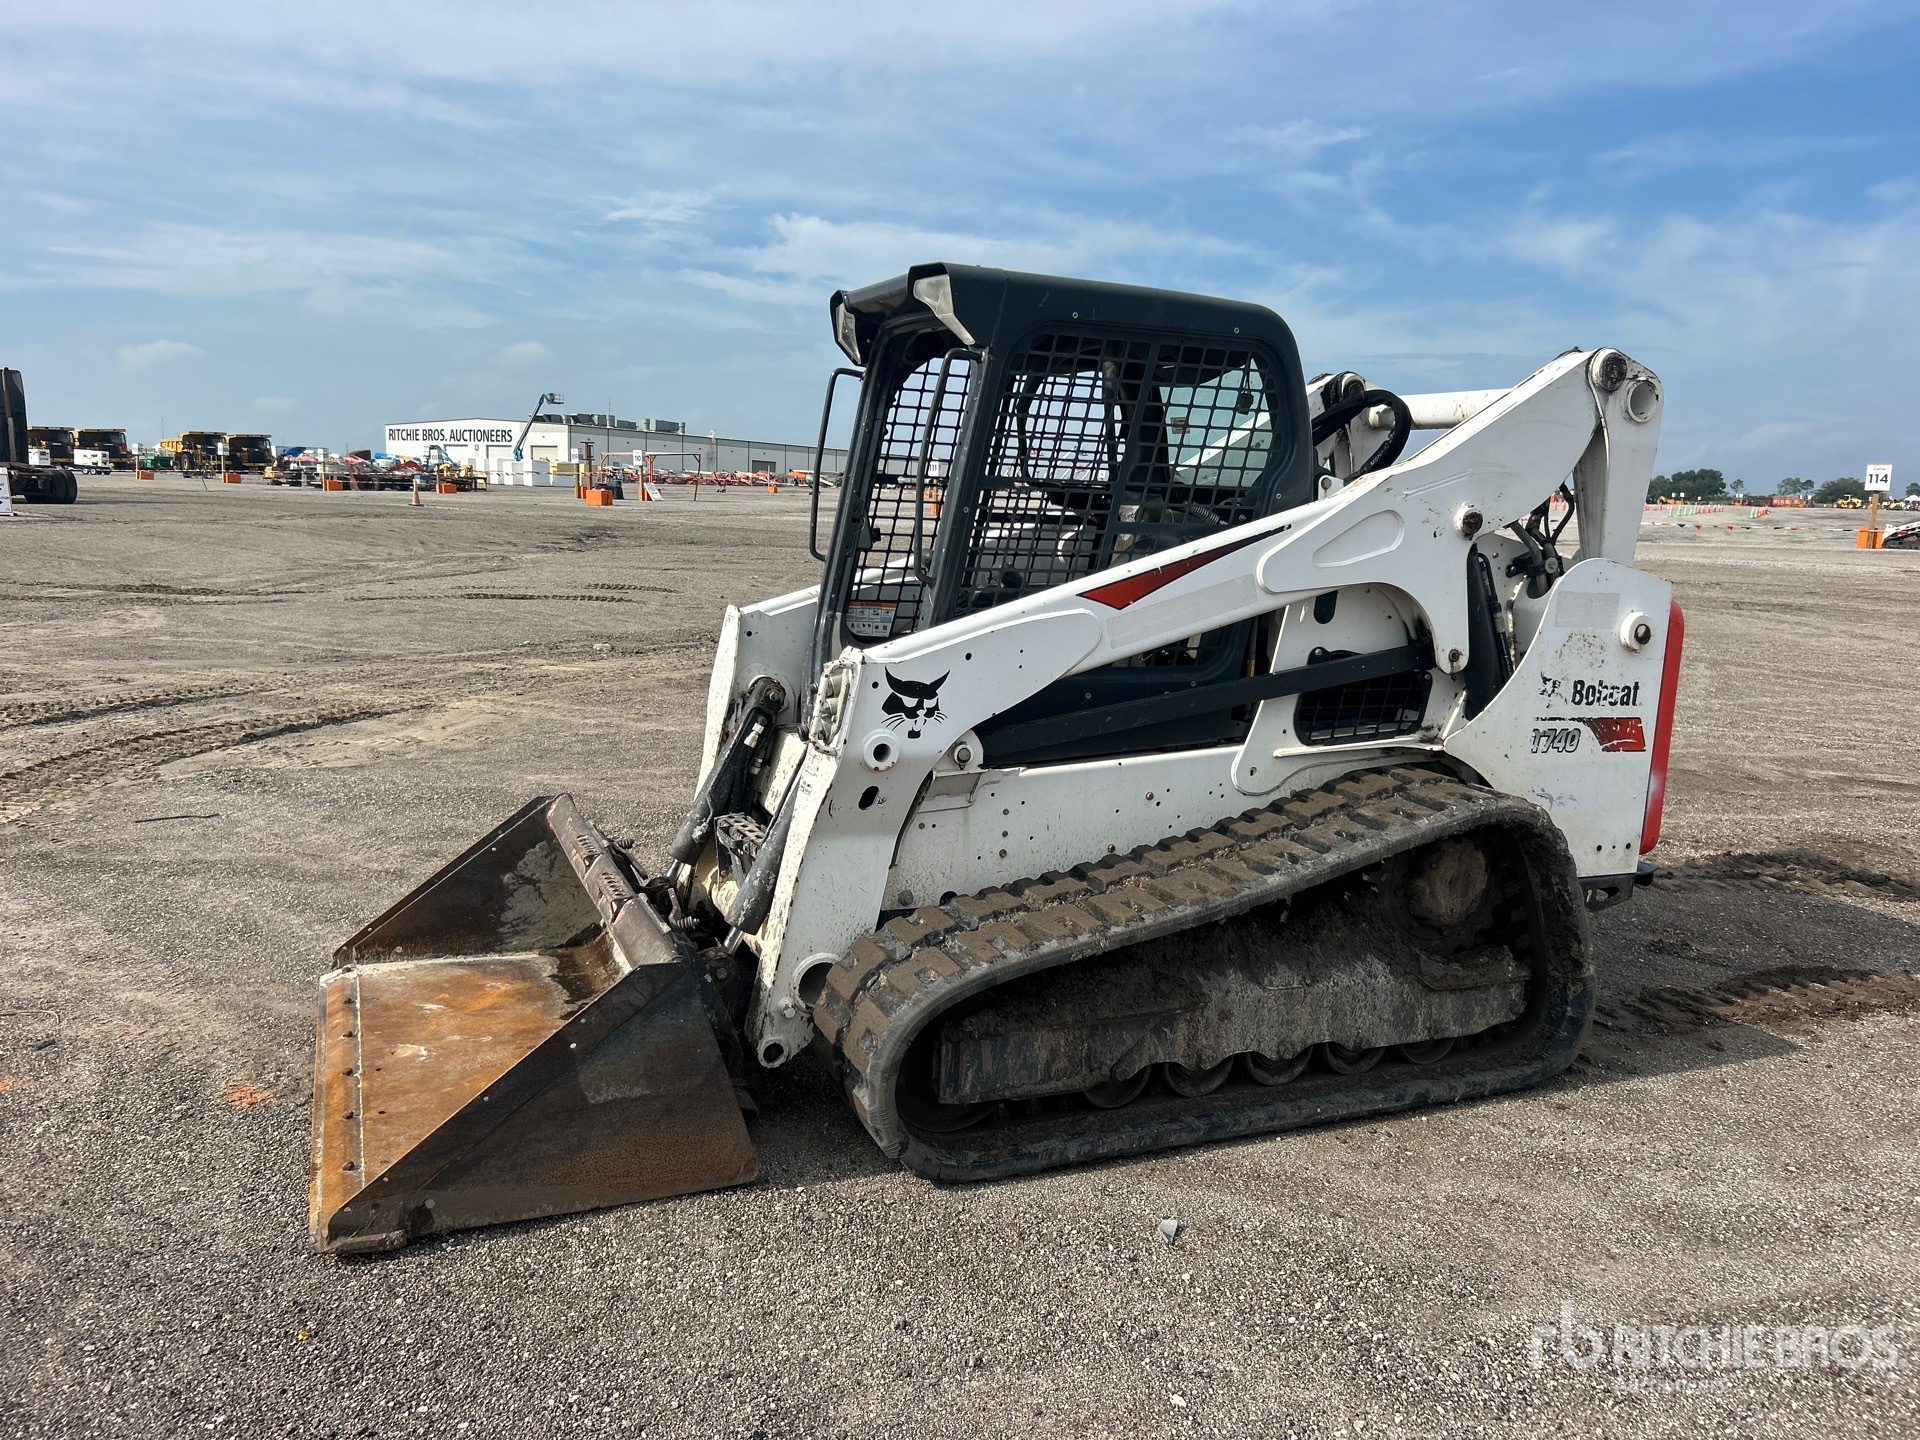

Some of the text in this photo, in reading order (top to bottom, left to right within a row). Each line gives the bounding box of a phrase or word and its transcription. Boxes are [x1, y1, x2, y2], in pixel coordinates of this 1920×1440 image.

[388, 429, 513, 442] RITCHIE BROS. AUCTIONEERS
[1868, 473, 1889, 484] 114
[1570, 679, 1640, 707] Bobcat
